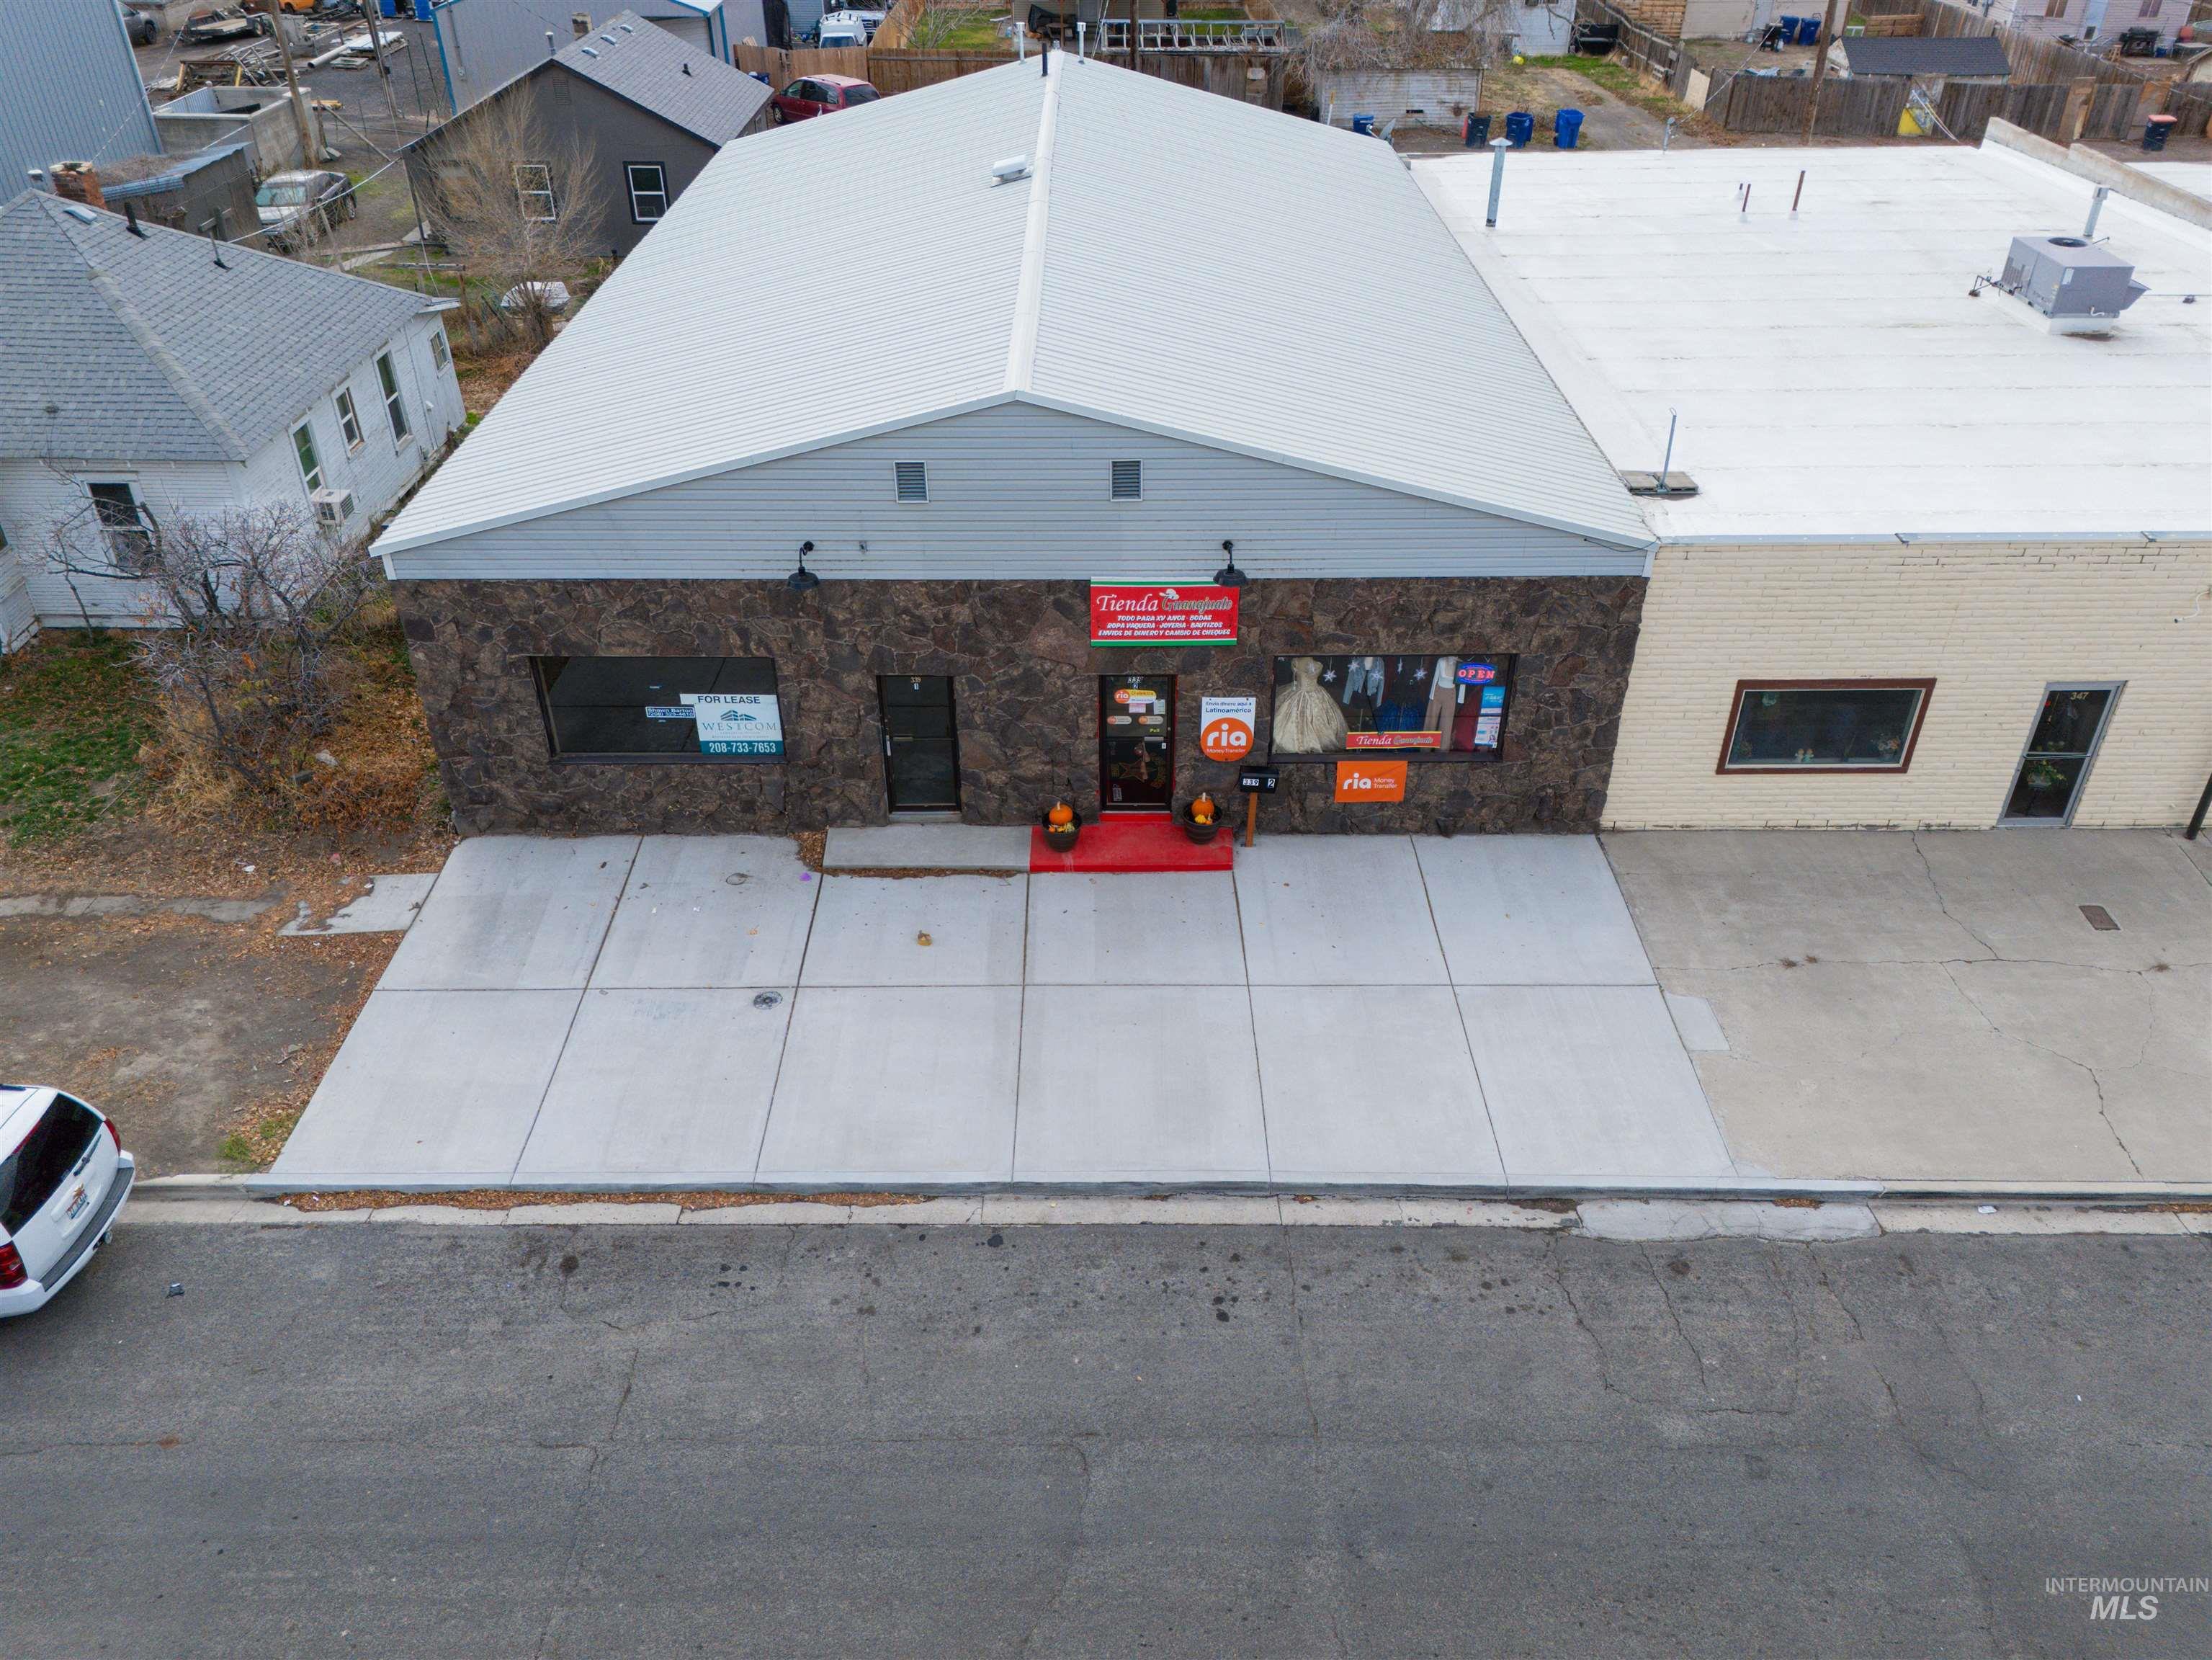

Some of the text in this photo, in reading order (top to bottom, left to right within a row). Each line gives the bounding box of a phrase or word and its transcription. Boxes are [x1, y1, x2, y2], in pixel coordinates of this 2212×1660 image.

[1096, 594, 1158, 612] Tienda
[1458, 669, 1495, 679] OPEN
[697, 695, 721, 704] FOR
[702, 722, 777, 731] WESTCOM
[1207, 723, 1247, 746] ria
[1356, 735, 1392, 745] Tienda
[709, 742, 776, 753] 208-733-7653
[1268, 779, 1274, 787] 2
[1343, 772, 1371, 790] ria
